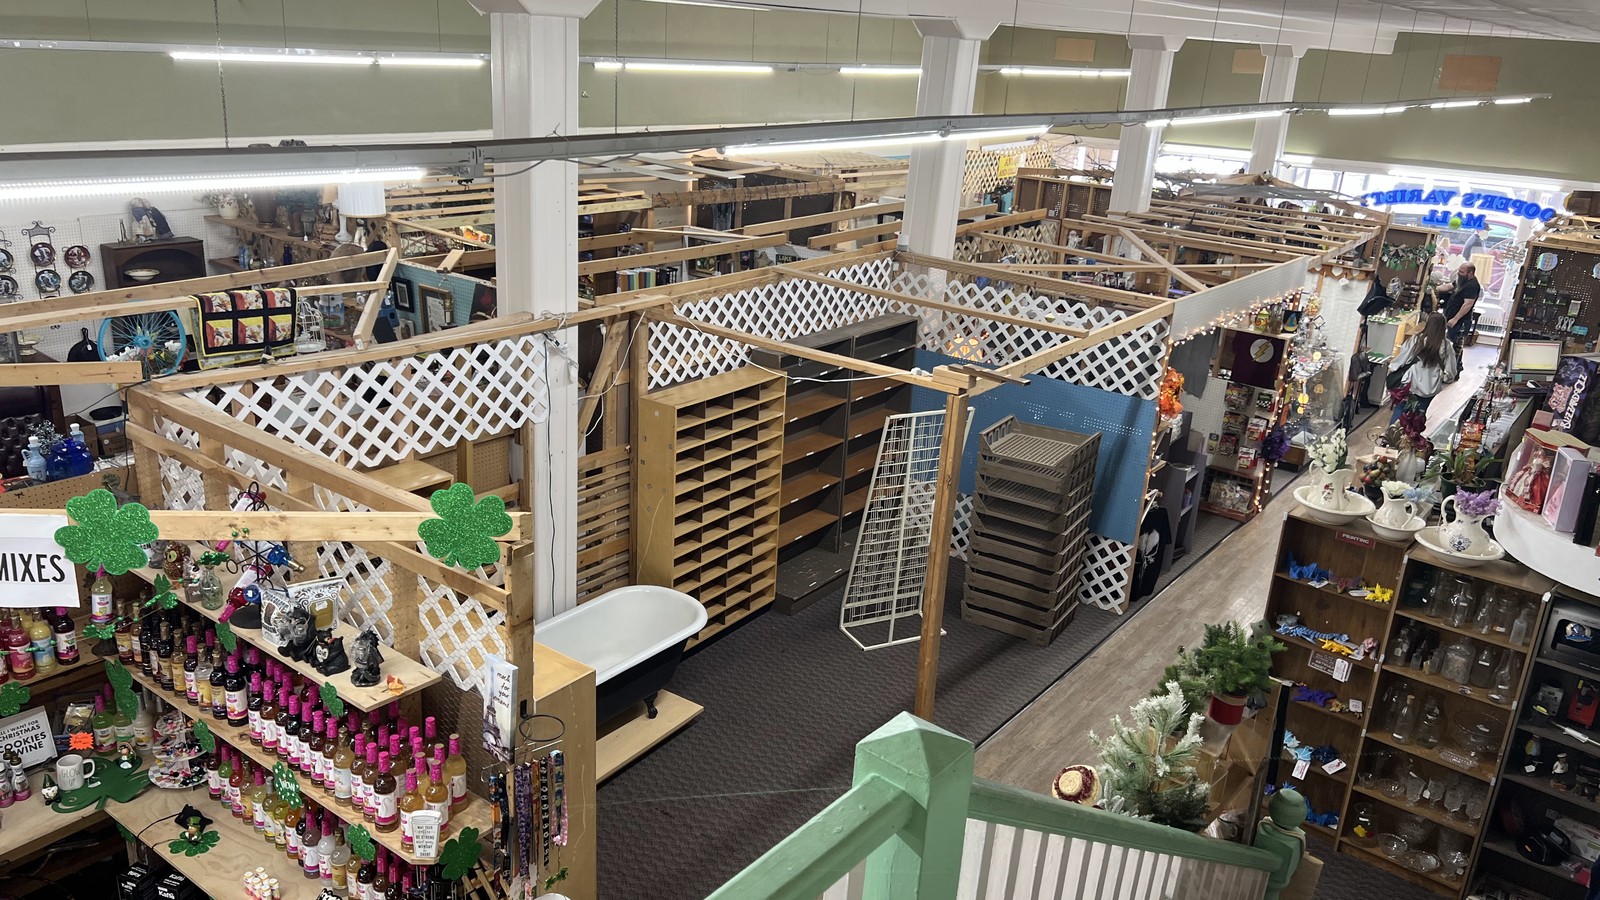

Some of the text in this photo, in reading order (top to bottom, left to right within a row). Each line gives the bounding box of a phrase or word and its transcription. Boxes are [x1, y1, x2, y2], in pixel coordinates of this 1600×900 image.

[10, 724, 27, 732] WANT
[61, 768, 81, 776] GLOW
[278, 777, 295, 792] WOW
